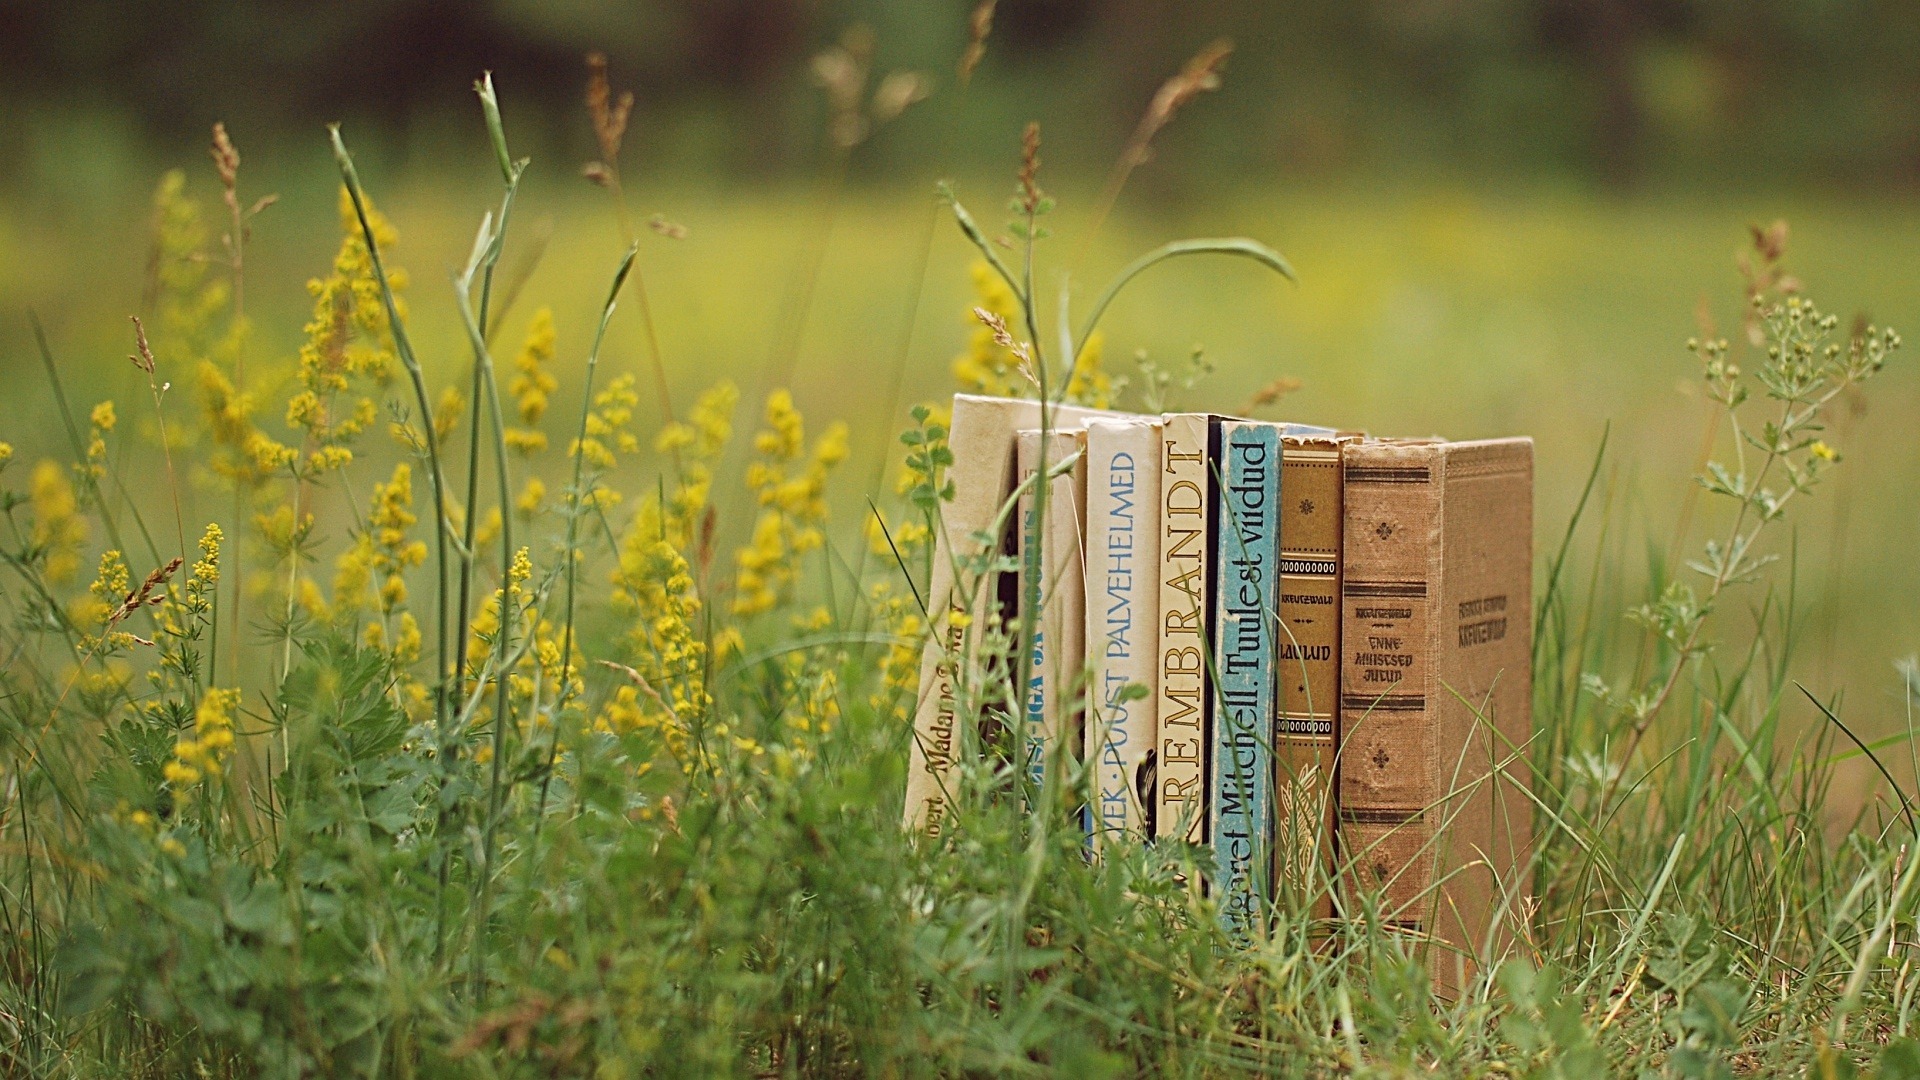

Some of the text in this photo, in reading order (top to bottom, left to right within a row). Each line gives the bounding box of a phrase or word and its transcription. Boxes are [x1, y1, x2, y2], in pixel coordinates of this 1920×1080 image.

[1230, 441, 1266, 543] viidud
[1026, 632, 1045, 666] JA
[1102, 451, 1136, 840] ZEK PUUST PALVEHELMED
[1165, 440, 1203, 806] REMBRANDT
[1226, 554, 1263, 674] Tuulest
[1280, 644, 1331, 661] LAULUD
